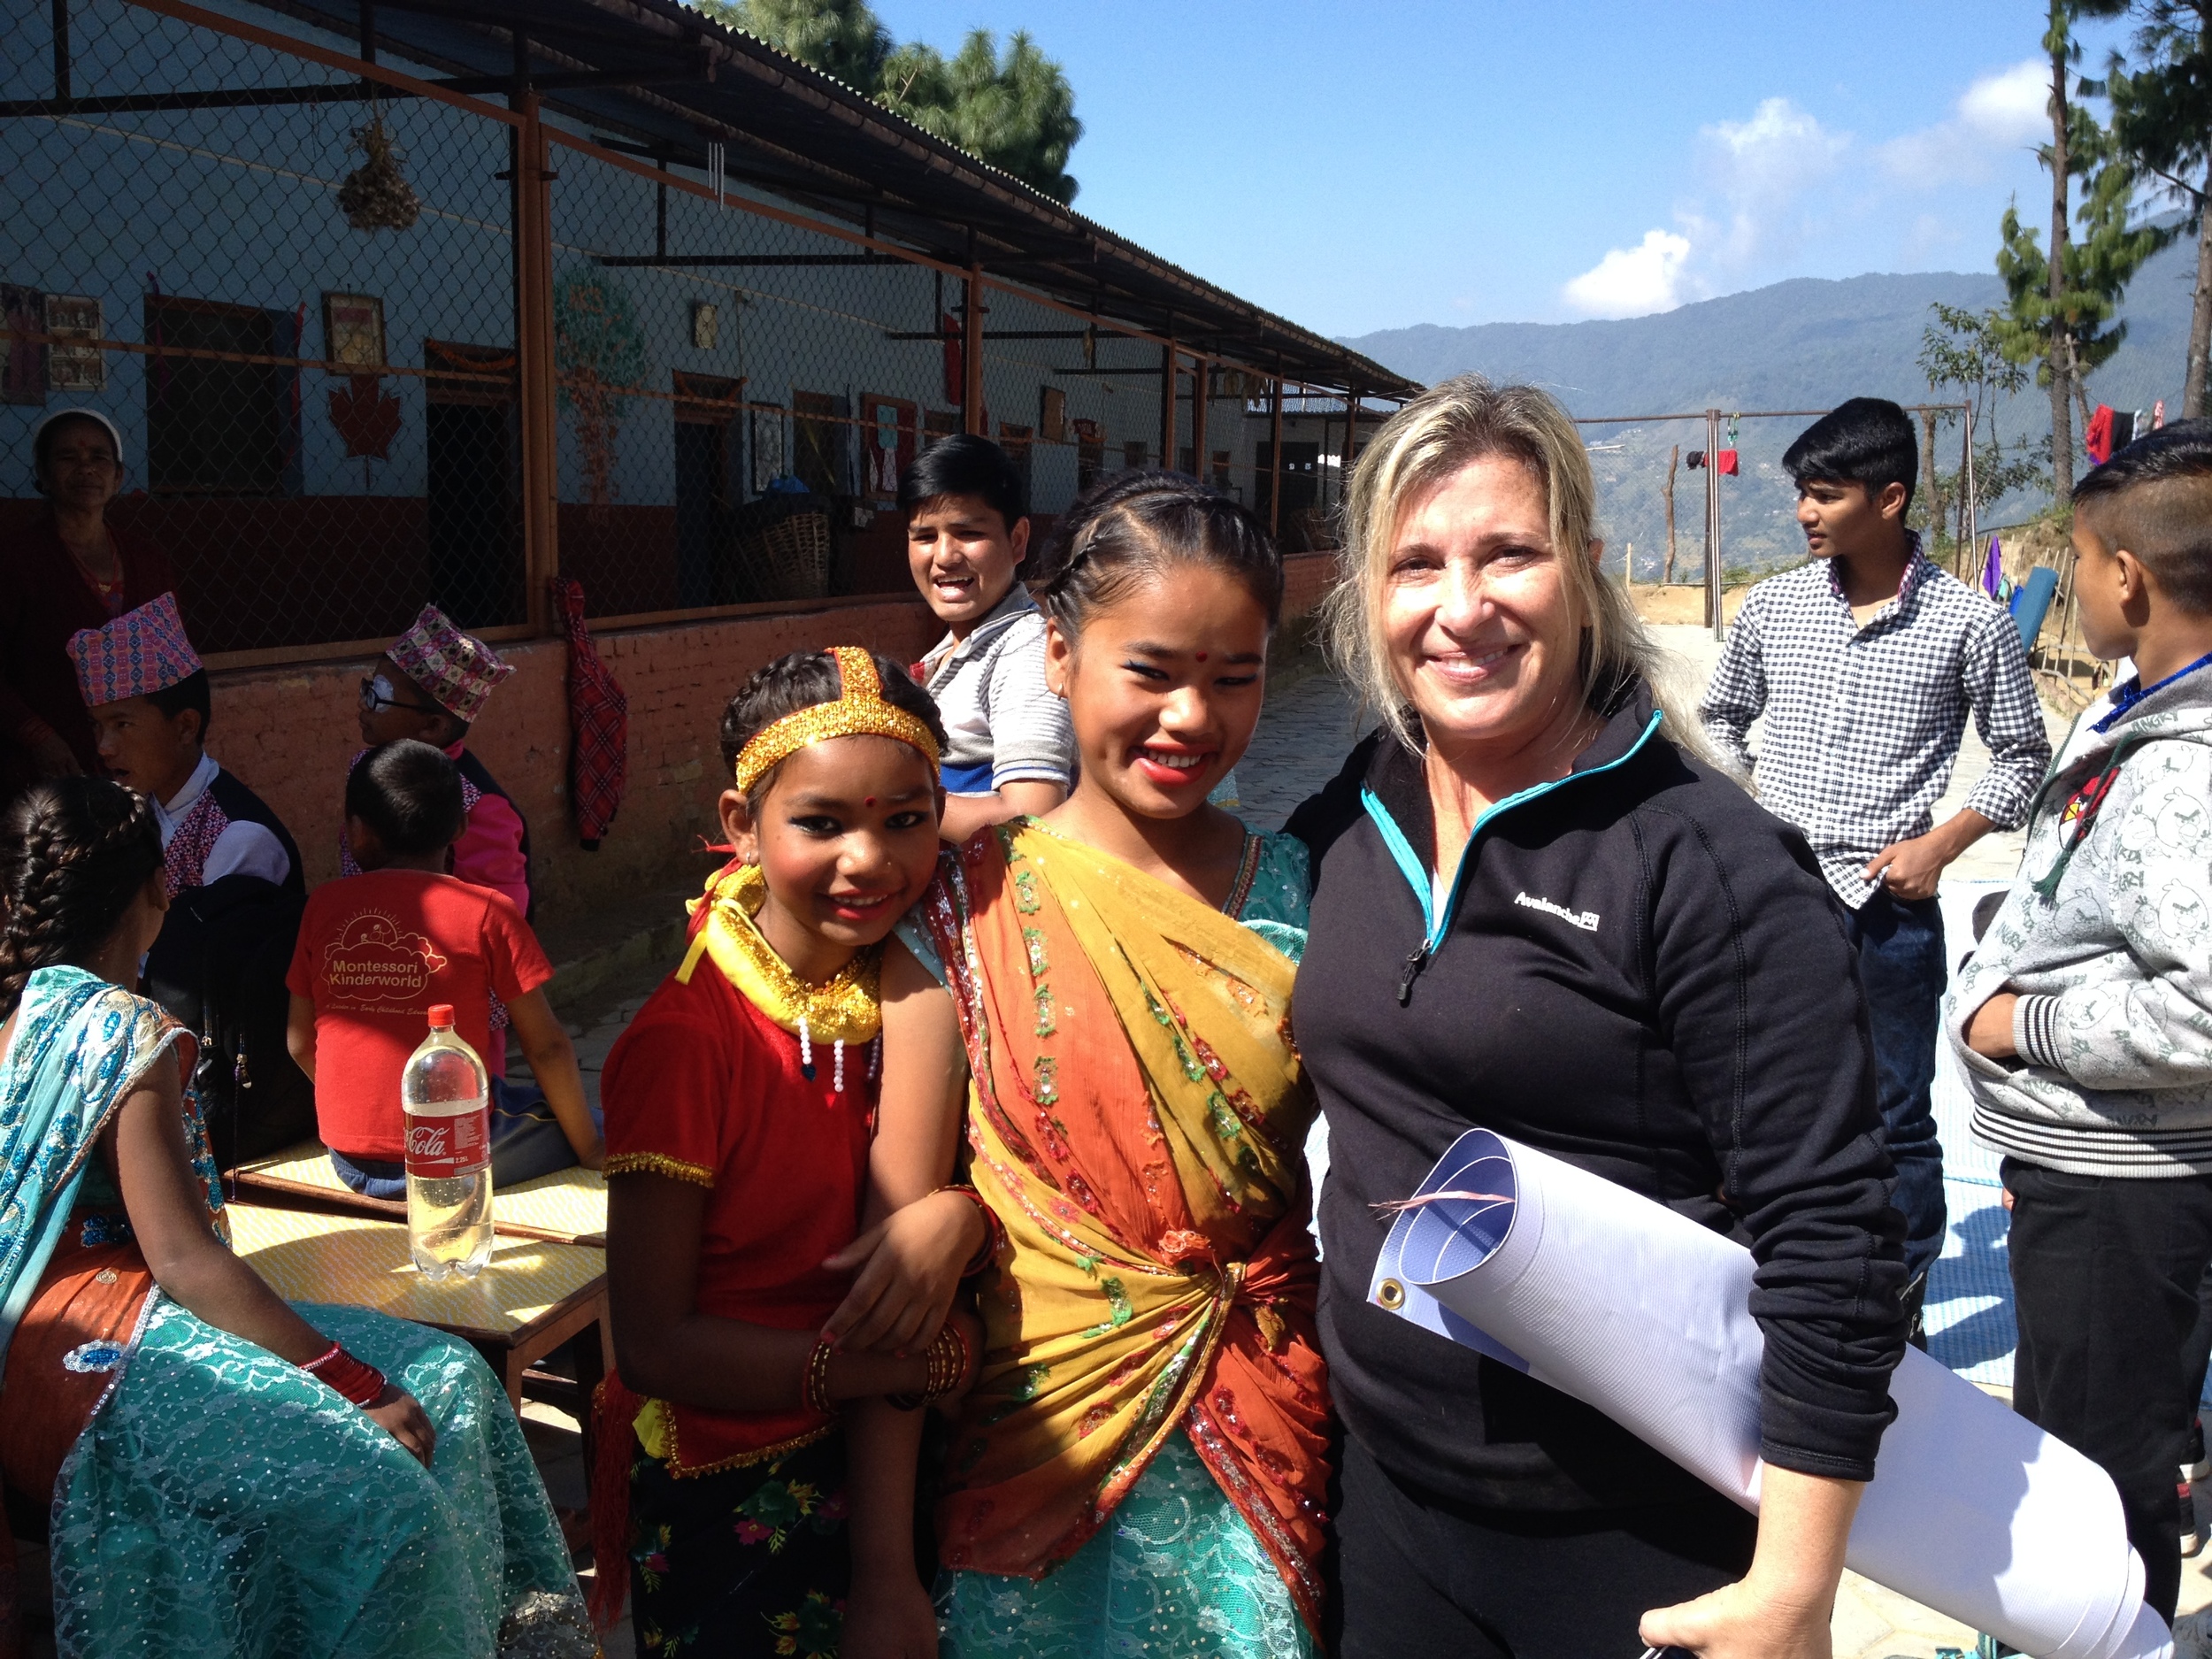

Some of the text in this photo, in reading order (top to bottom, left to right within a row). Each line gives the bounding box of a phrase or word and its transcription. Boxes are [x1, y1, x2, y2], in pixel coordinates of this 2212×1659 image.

[2131, 709, 2179, 734] ANGRY
[1514, 891, 1581, 926] Avalanche
[333, 960, 419, 974] Montessori
[329, 973, 422, 988] Kinderworld
[377, 1005, 406, 1015] Childhood
